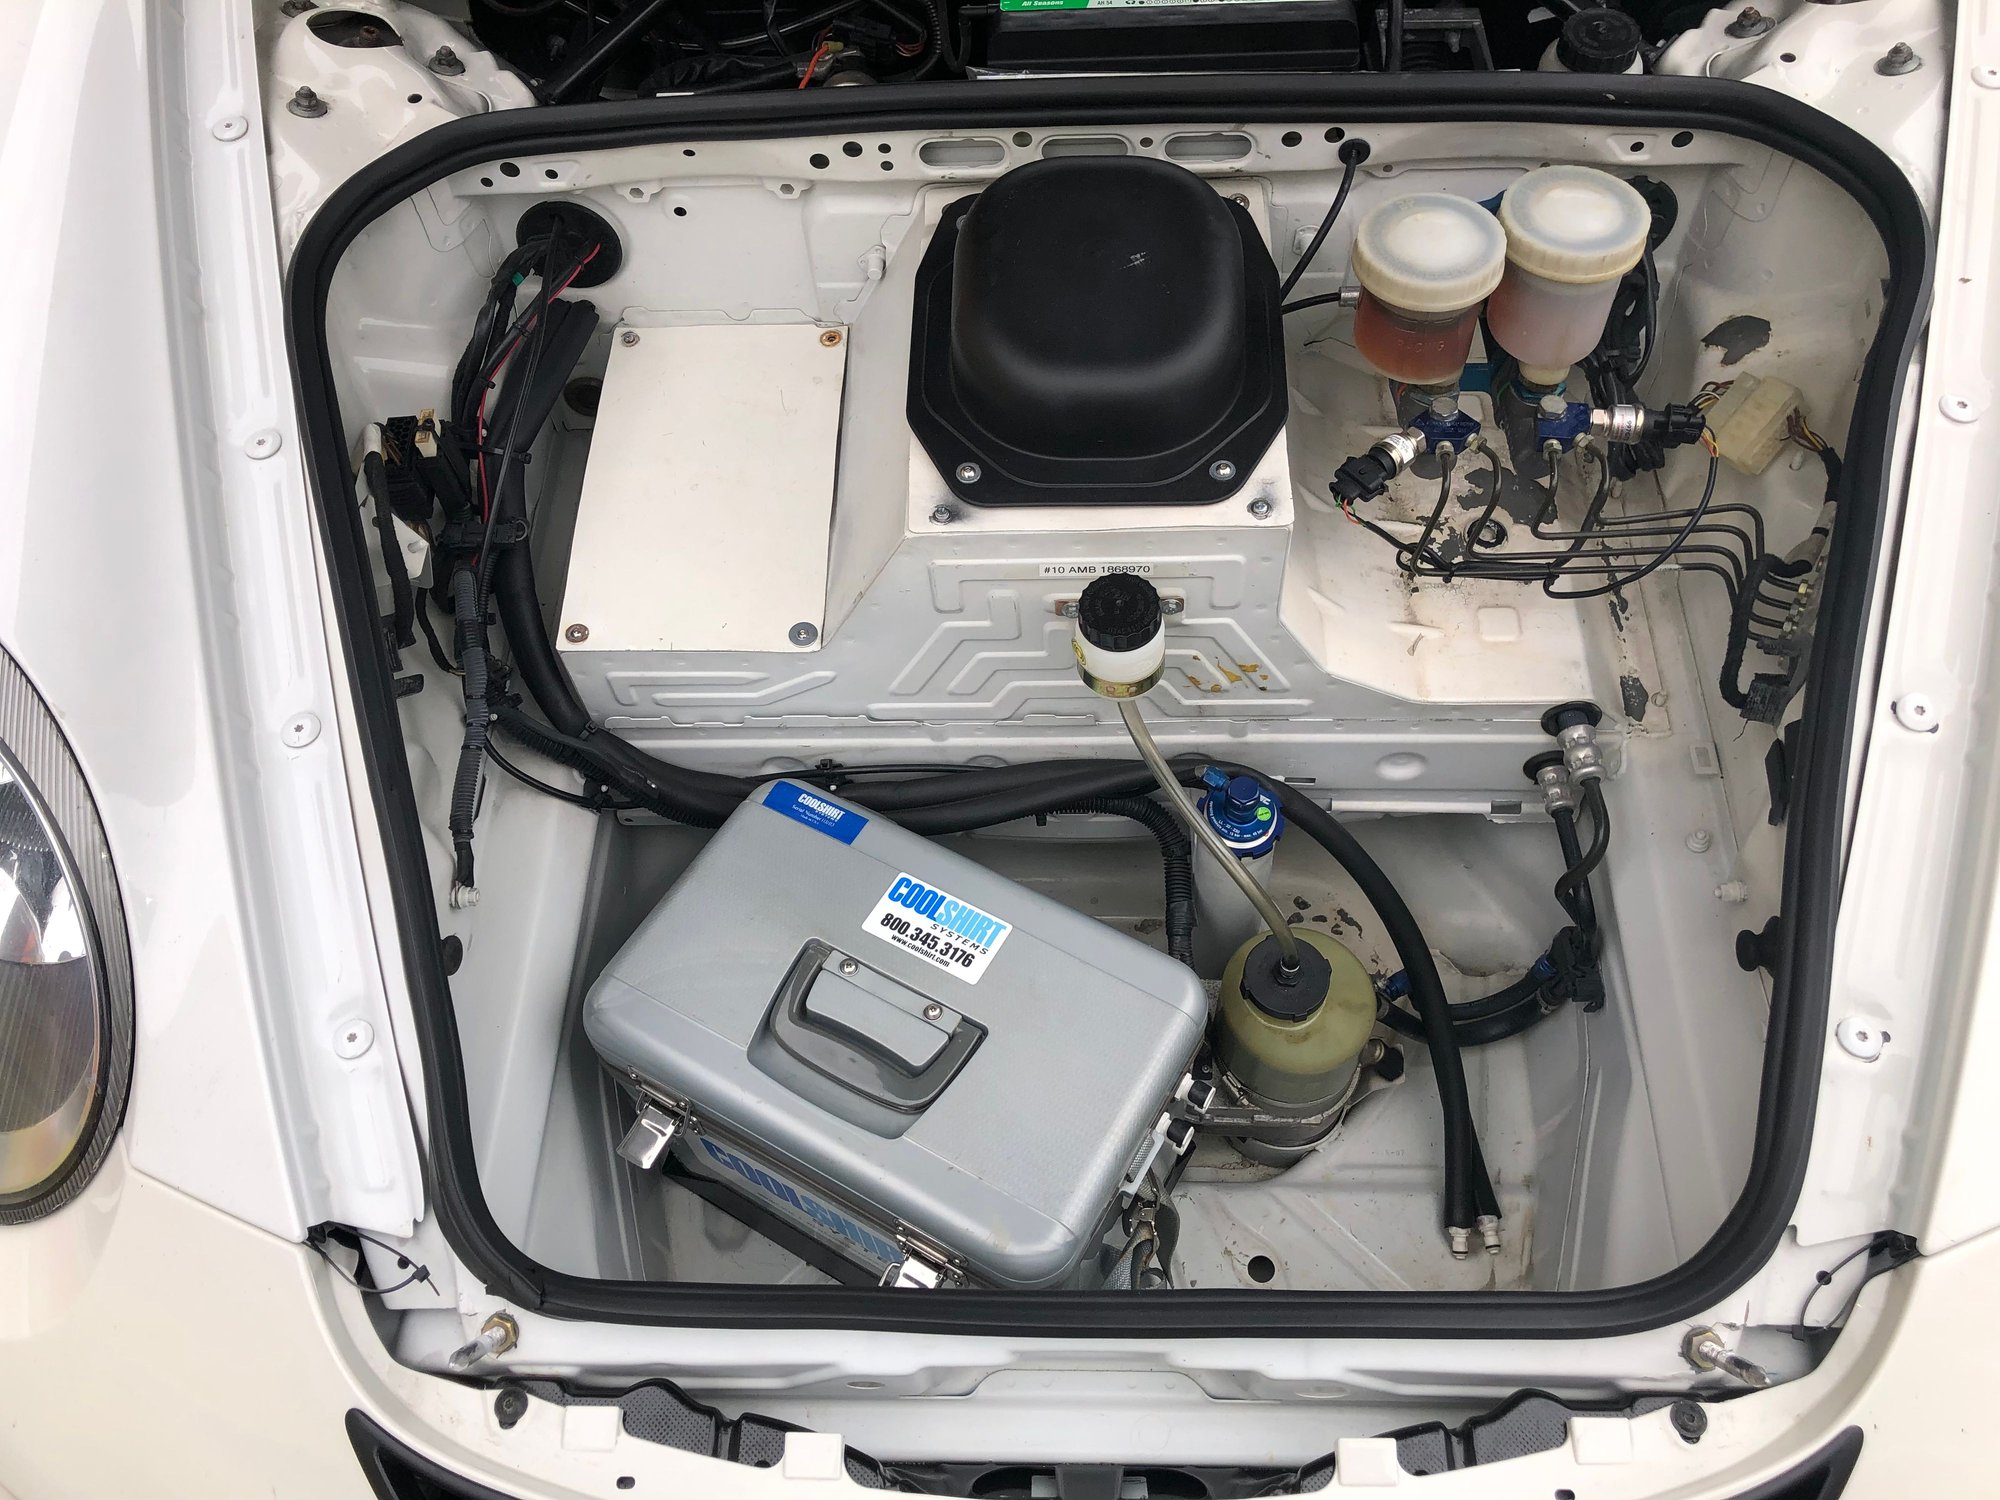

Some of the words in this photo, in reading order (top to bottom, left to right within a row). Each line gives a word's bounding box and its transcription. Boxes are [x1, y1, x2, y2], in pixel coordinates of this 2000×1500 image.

[1044, 566, 1065, 574] #10
[1068, 566, 1097, 574] AMB
[1101, 565, 1151, 573] 1868970
[797, 793, 845, 822] COOLSHIRT
[887, 876, 1008, 949] COOLSHIRT
[880, 912, 976, 969] 800.345.3176
[891, 933, 950, 968] www.coolshirt.com
[929, 923, 989, 956] SYSTEMS
[699, 1136, 906, 1264] COOLSHIR
